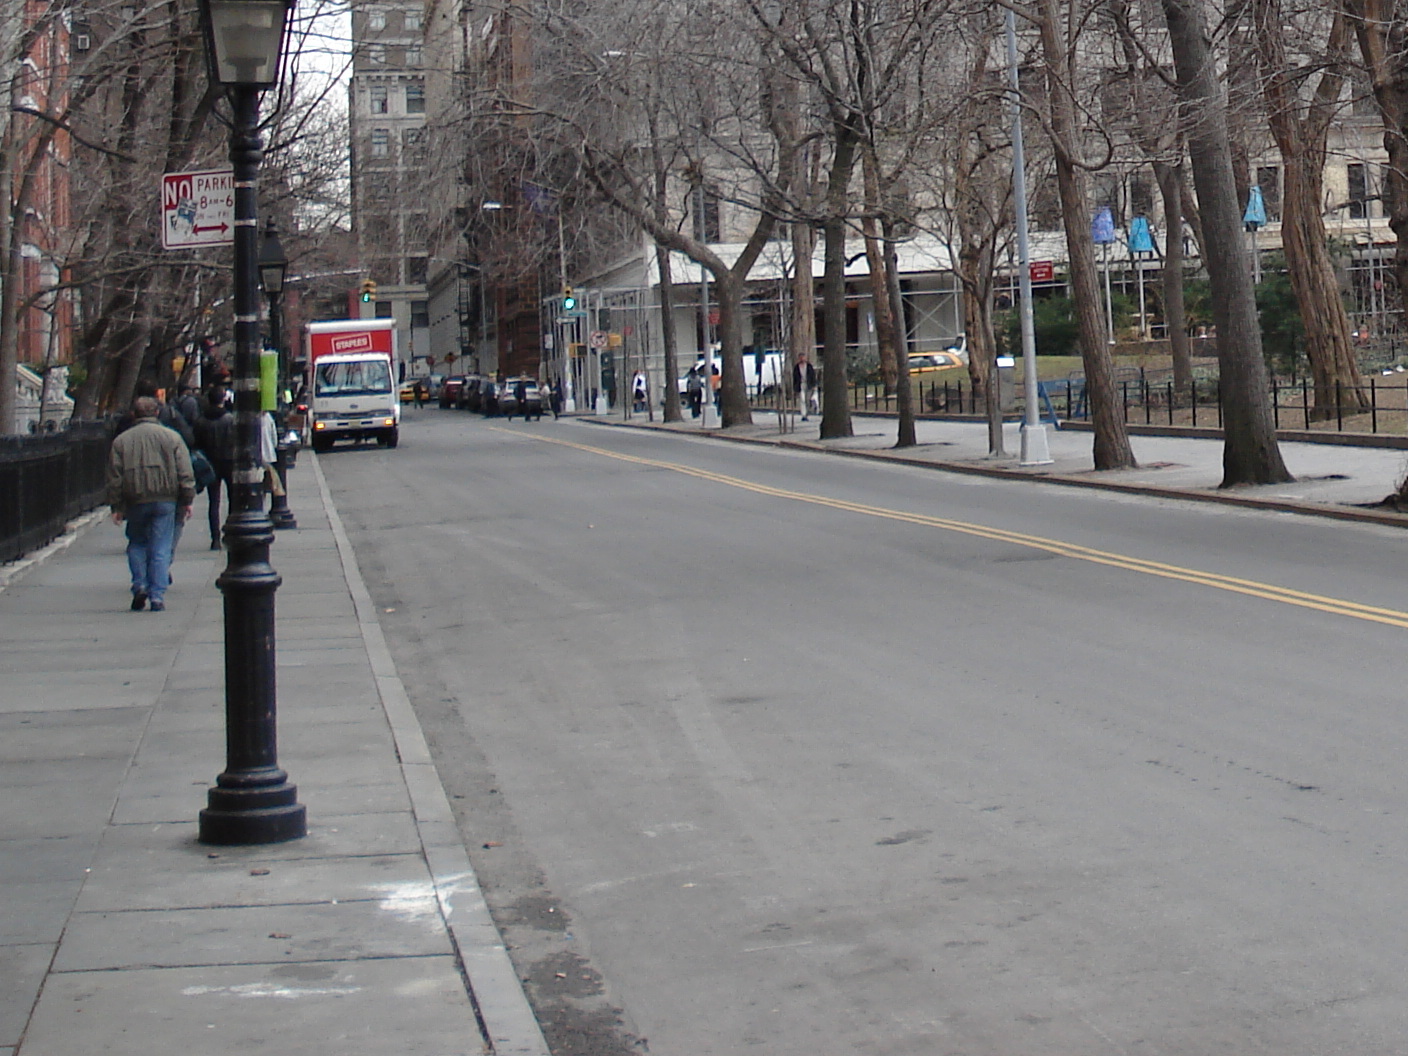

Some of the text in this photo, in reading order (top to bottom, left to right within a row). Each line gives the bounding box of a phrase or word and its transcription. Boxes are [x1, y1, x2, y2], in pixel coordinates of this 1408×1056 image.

[165, 176, 234, 206] NO PARKI
[335, 337, 368, 350] STAPLES
